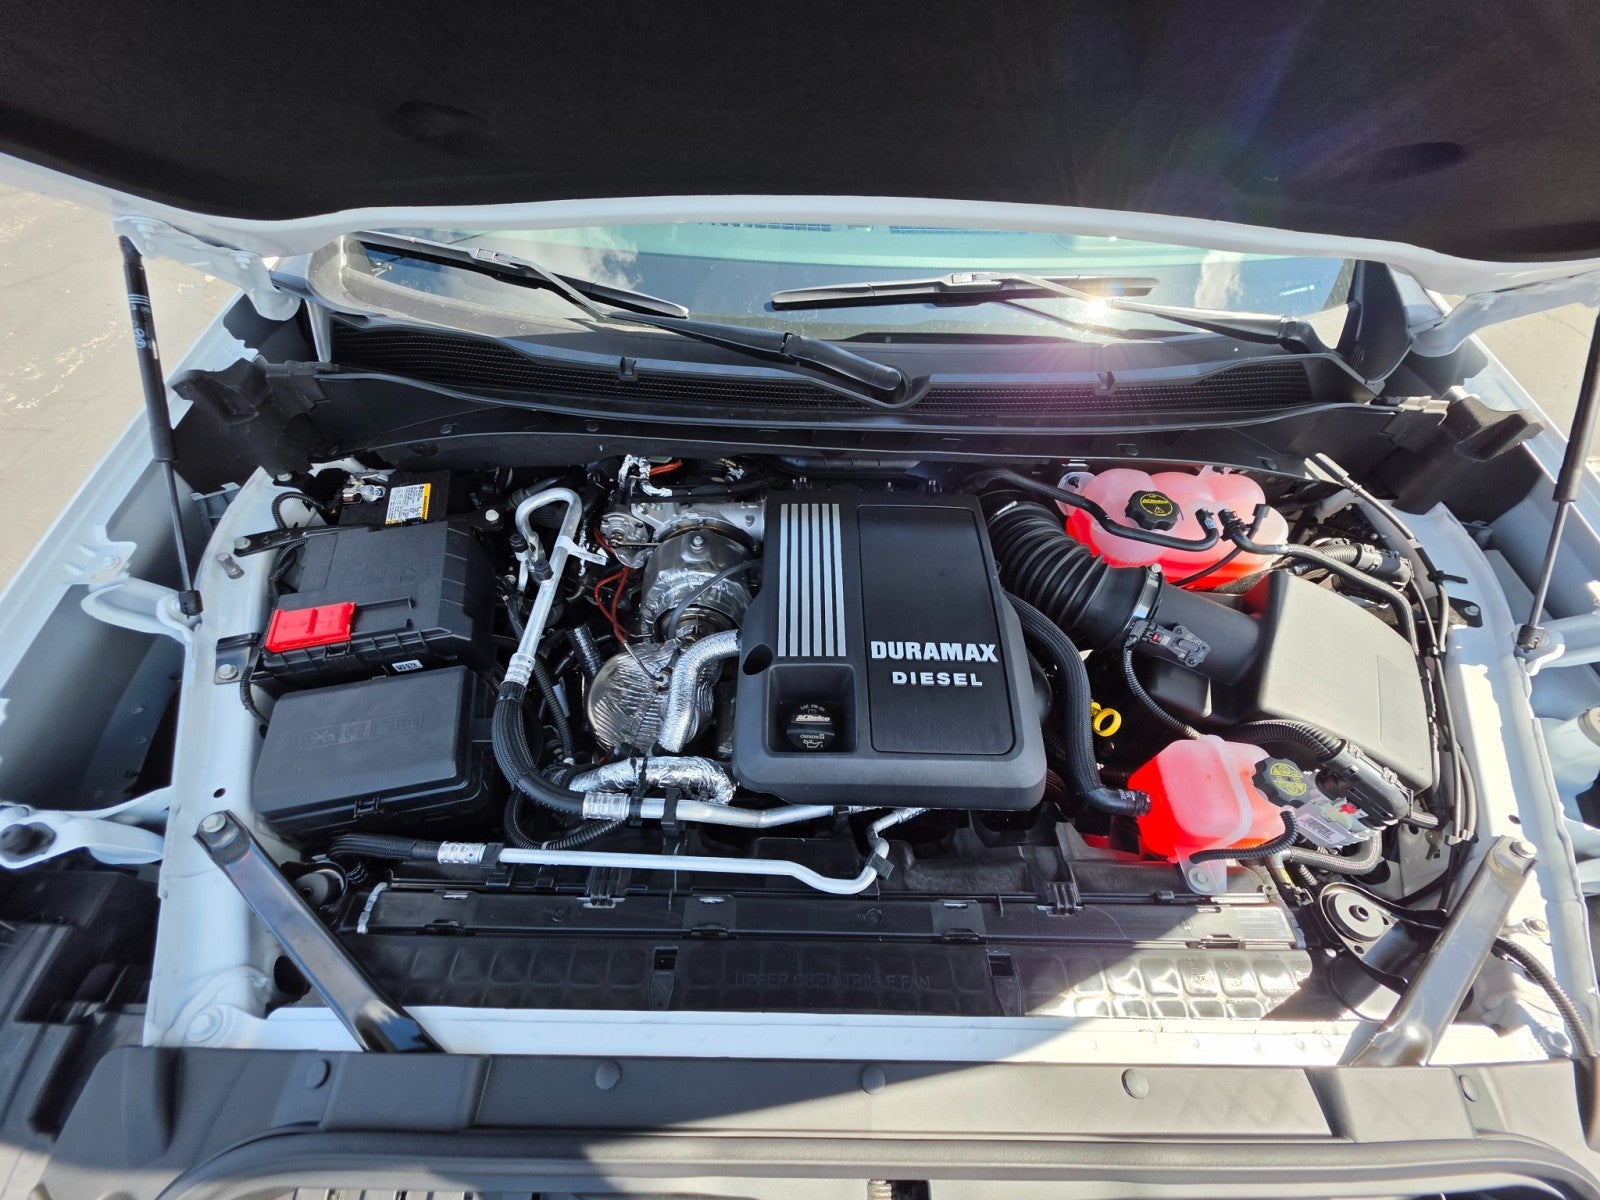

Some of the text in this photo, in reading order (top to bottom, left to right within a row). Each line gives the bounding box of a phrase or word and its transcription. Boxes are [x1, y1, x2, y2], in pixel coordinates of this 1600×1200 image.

[870, 641, 999, 662] DURAMAX
[892, 671, 983, 686] DIESEL
[795, 714, 831, 722] ACDelco
